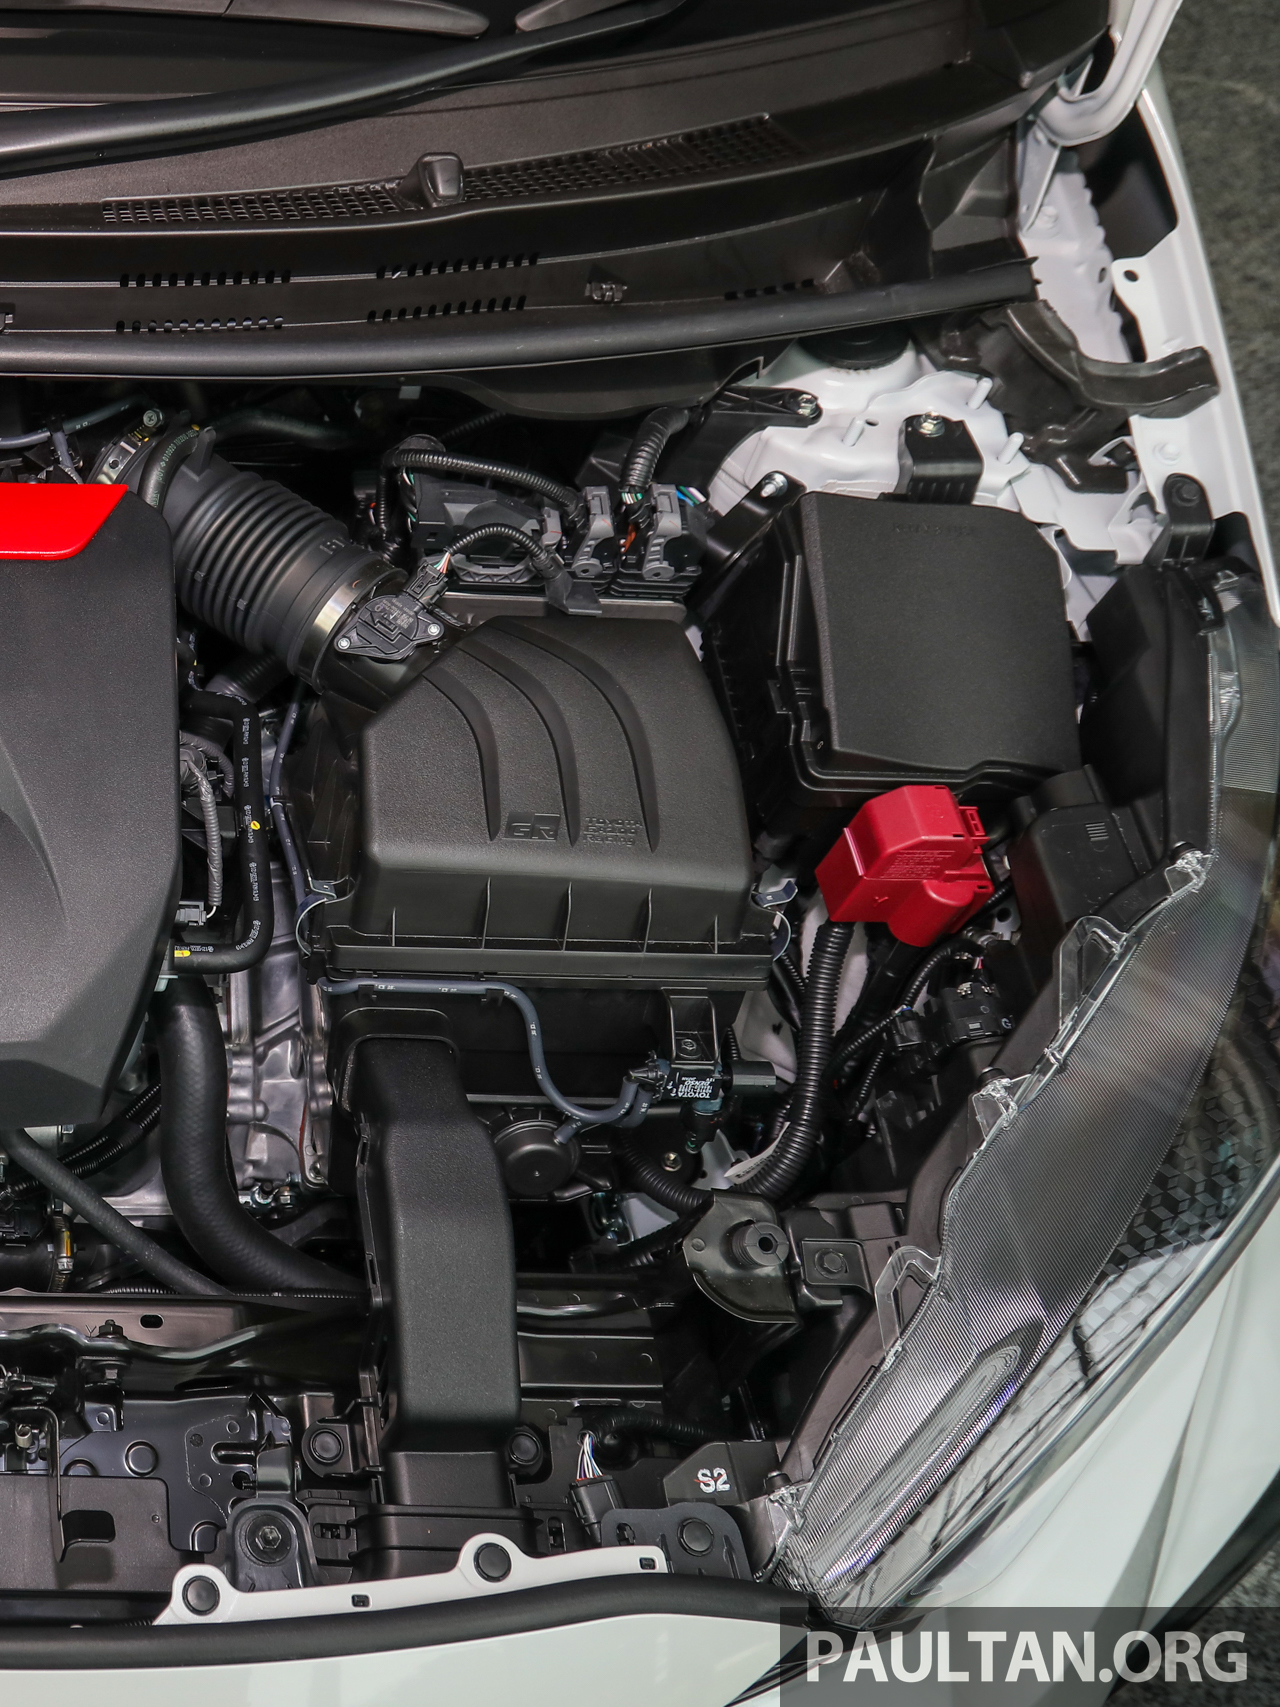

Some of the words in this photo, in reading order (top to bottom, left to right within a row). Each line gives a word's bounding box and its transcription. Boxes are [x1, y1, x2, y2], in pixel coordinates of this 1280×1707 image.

[585, 816, 643, 829] TOYOTA
[510, 822, 555, 840] GR
[1001, 1017, 1013, 1030] G
[697, 1467, 731, 1493] S2
